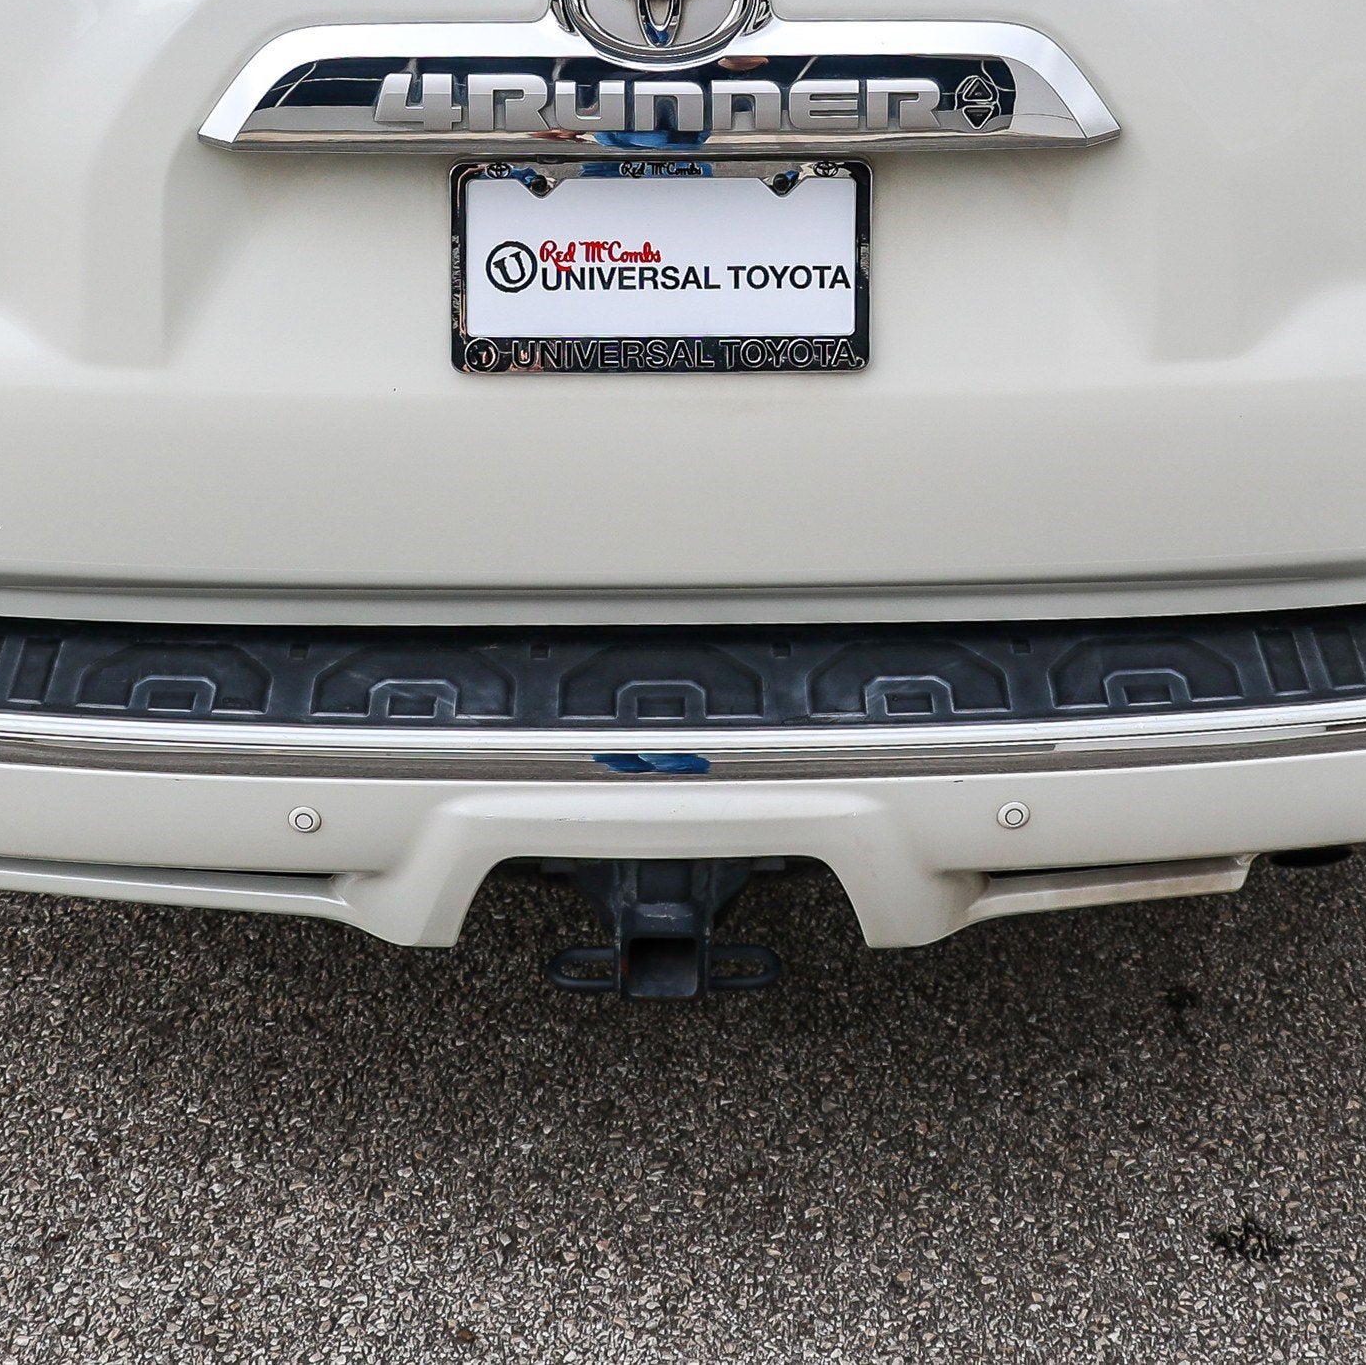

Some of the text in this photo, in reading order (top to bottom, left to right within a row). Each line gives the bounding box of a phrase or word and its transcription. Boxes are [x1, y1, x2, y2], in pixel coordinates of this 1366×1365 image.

[539, 240, 661, 271] Red McCombs
[541, 265, 852, 291] UNIVERSAL TOYOTA
[511, 339, 716, 368] UNIVERSAL
[719, 338, 858, 368] TOYOTA
